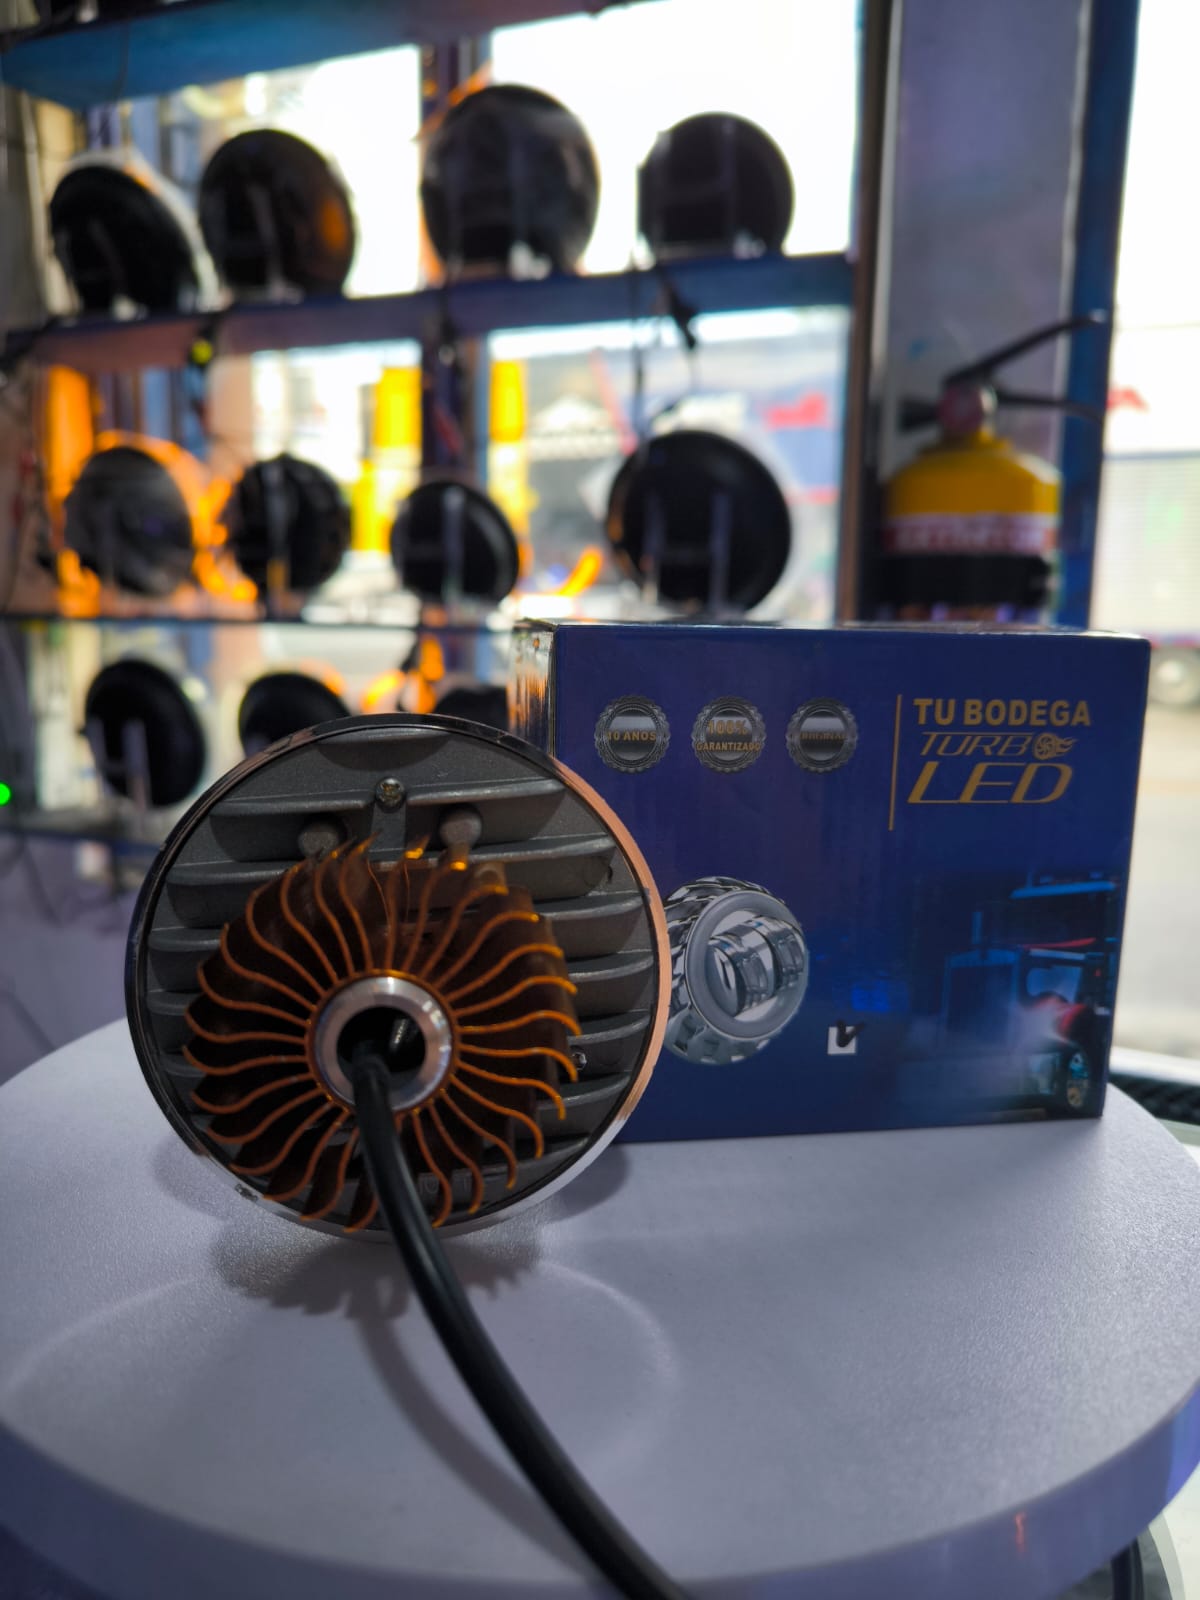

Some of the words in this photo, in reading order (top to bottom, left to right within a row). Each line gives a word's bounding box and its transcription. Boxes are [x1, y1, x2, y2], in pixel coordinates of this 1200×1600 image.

[913, 698, 955, 725] TU
[963, 699, 1091, 727] BODEGA
[706, 719, 749, 734] 100%
[696, 741, 761, 752] GARANTIZADO
[907, 761, 1073, 804] LED
